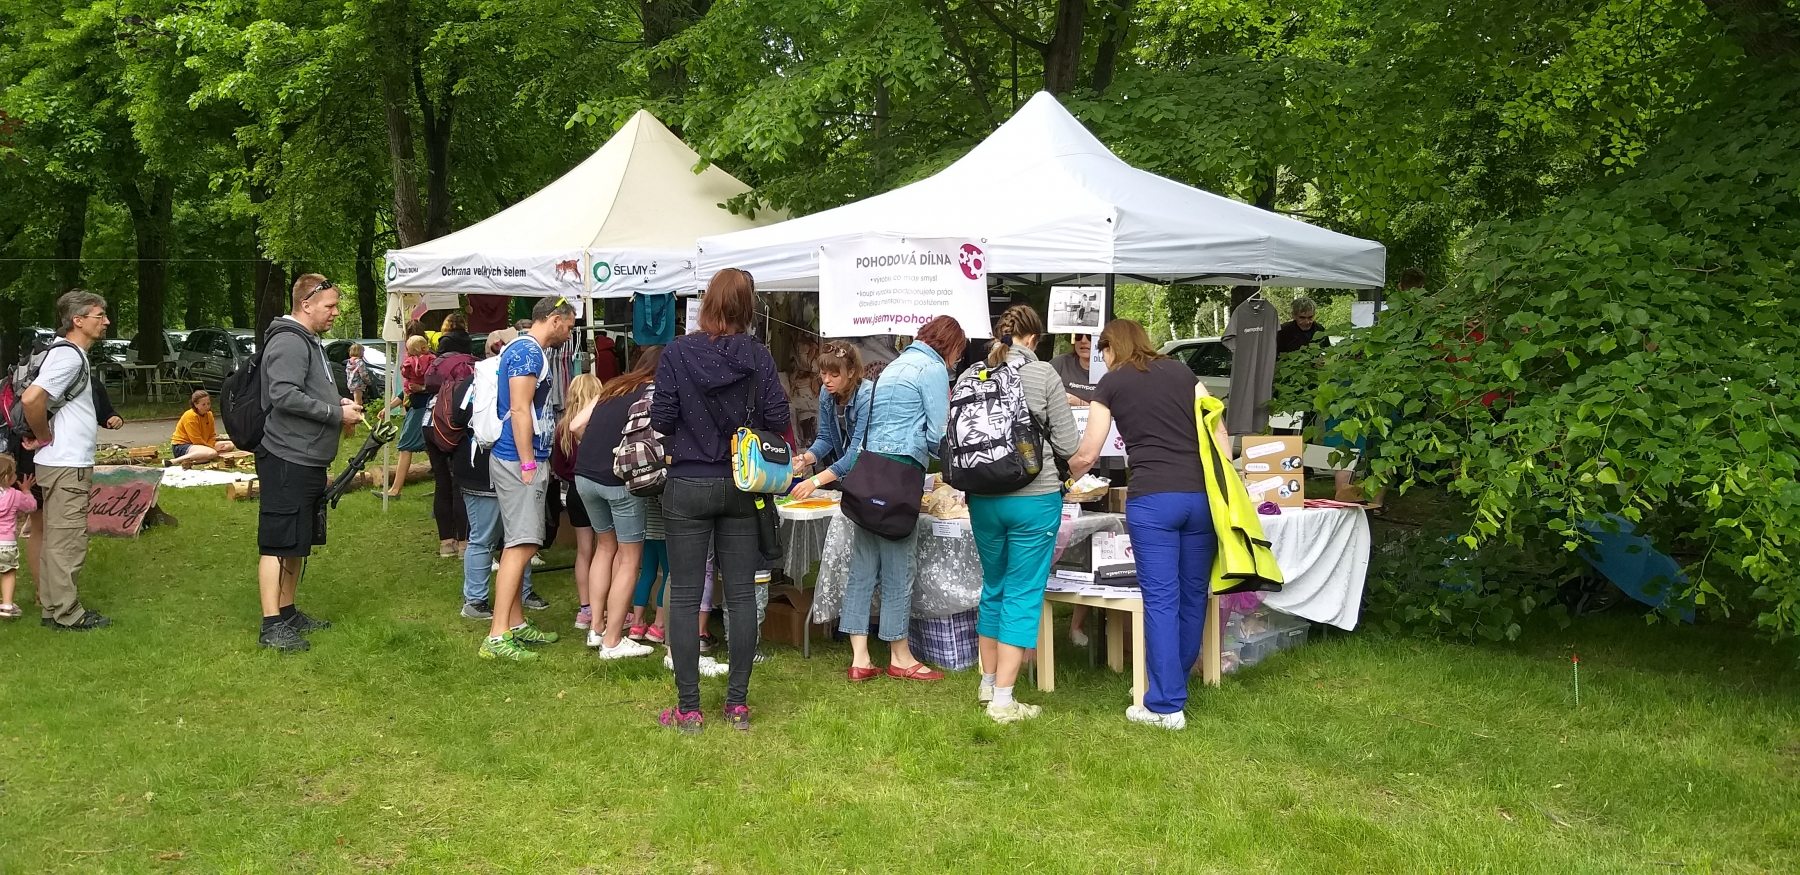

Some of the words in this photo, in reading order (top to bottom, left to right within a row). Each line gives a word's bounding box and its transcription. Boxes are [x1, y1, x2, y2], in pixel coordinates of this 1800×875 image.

[856, 250, 917, 269] POHODOVÁ
[919, 250, 952, 266] DÍLNA
[441, 266, 471, 277] Ochrana
[473, 265, 502, 279] velkých
[503, 266, 527, 278] šelem
[613, 263, 648, 276] ŠELMY
[920, 274, 938, 283] smysl
[892, 287, 936, 296] podporujete
